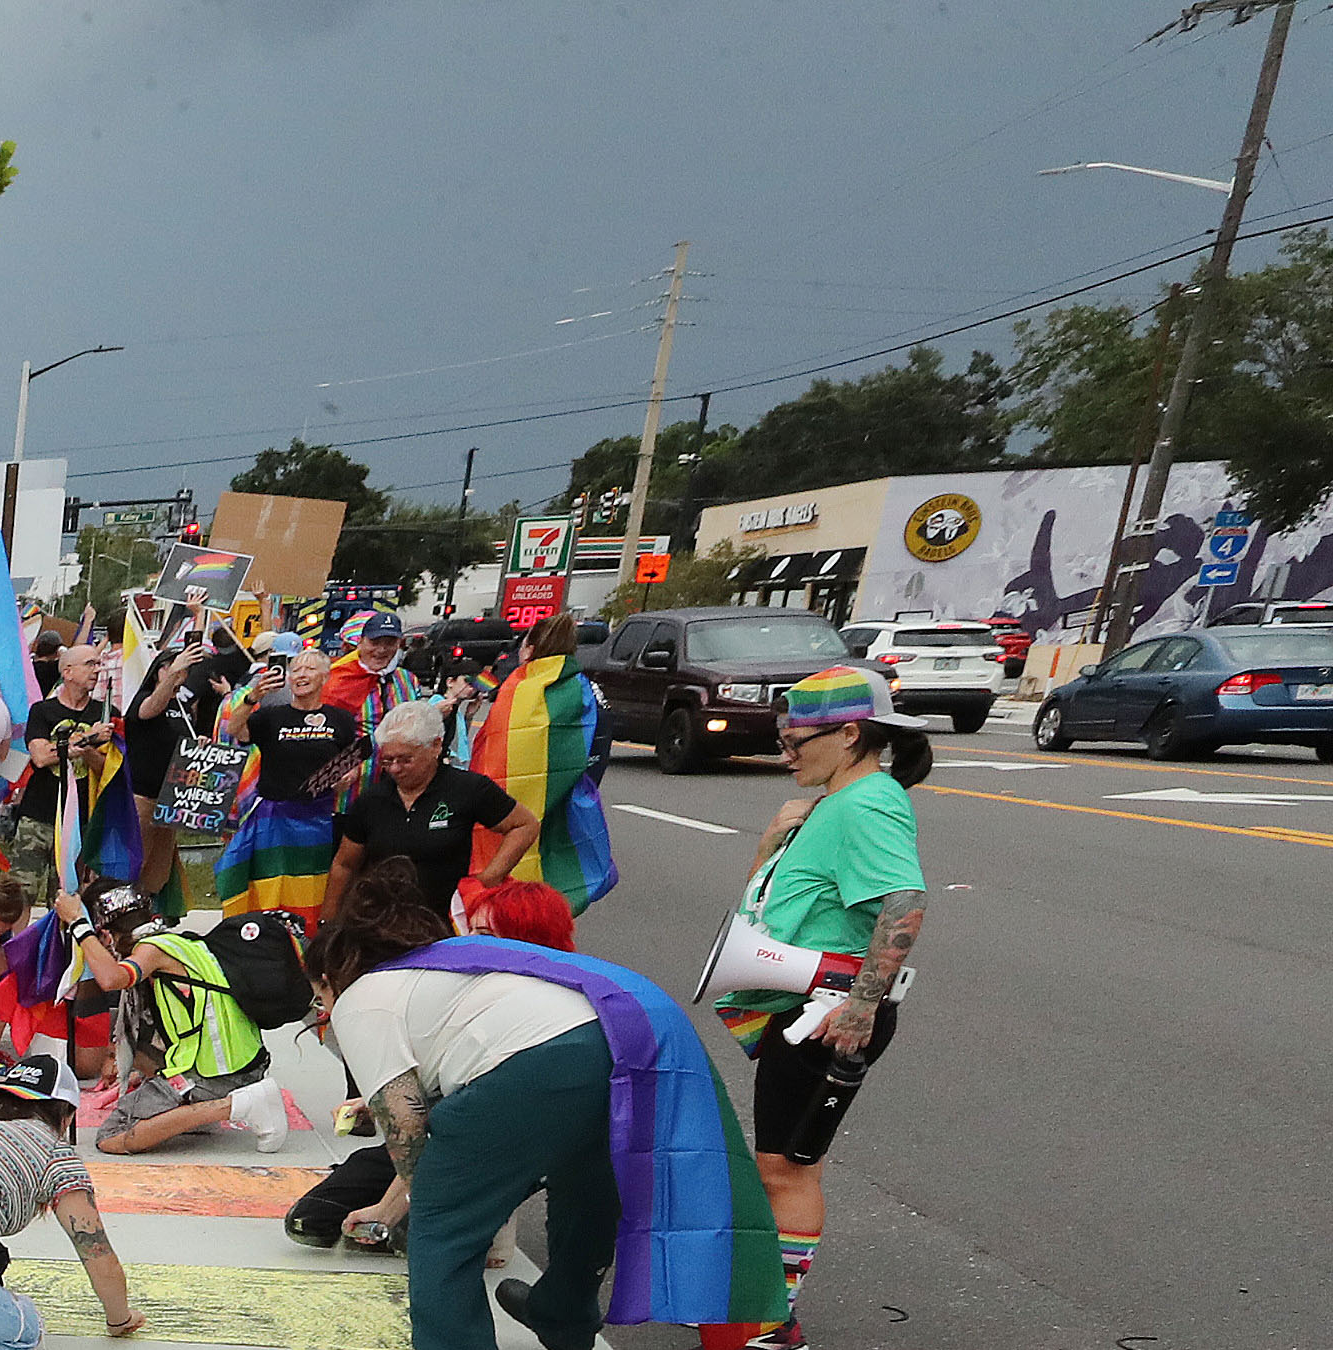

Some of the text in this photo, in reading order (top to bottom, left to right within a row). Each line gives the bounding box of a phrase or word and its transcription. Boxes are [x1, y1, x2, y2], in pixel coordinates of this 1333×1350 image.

[1217, 537, 1234, 556] 4
[180, 739, 247, 764] WHERE'S
[186, 761, 214, 773] MY
[174, 787, 224, 804] WHERE'S
[173, 800, 200, 811] MY
[153, 804, 225, 832] JUSTICE?
